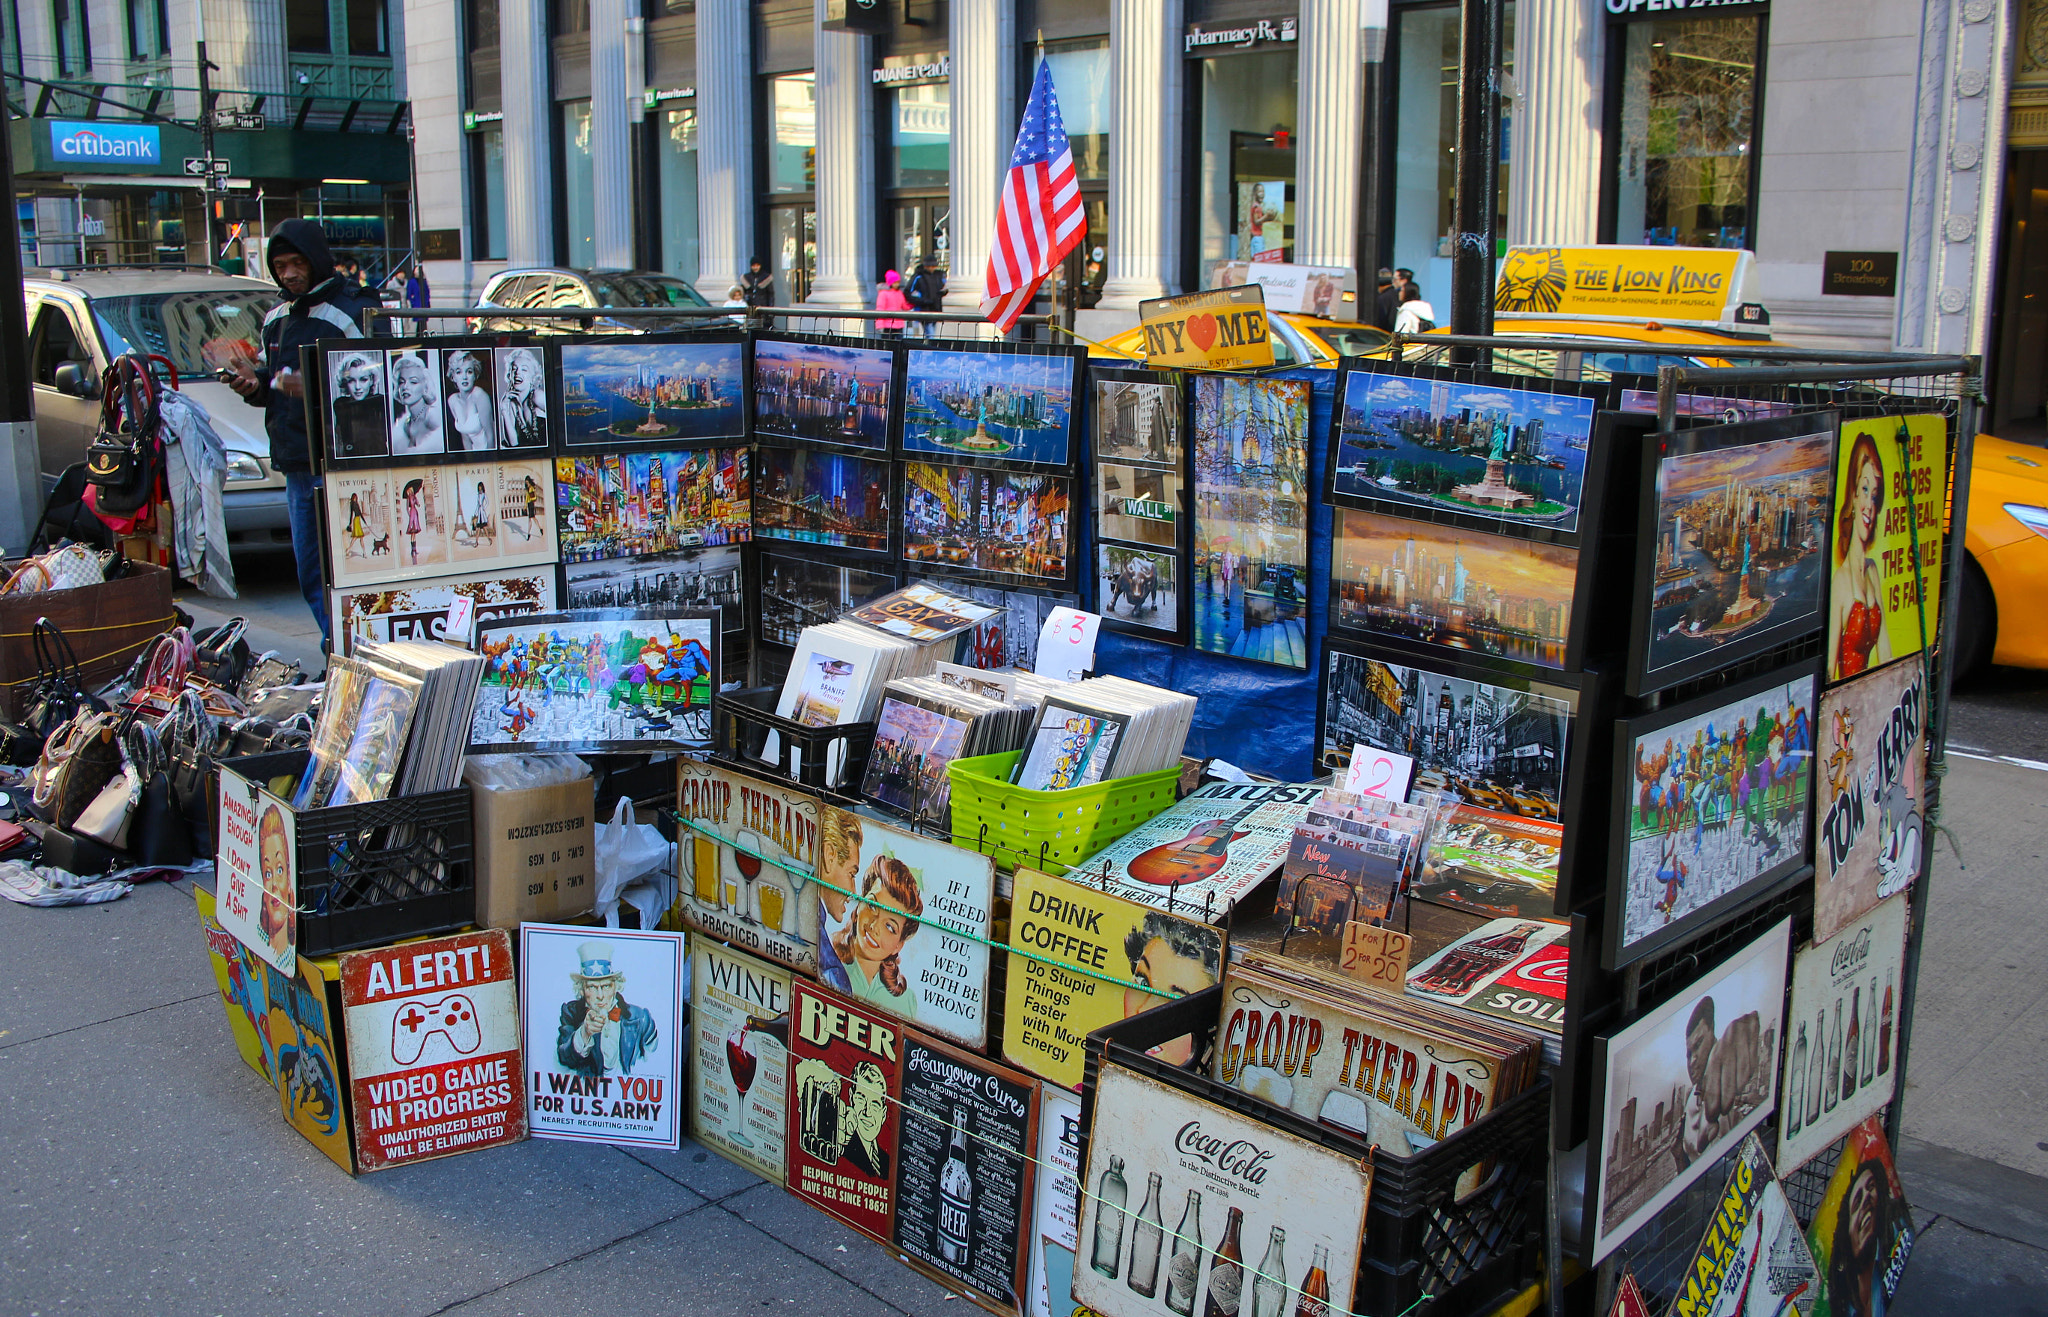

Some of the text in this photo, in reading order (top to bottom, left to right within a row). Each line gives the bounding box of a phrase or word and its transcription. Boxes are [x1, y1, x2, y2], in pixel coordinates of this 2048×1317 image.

[656, 87, 694, 100] Ameritrade
[61, 134, 152, 158] citibank
[324, 222, 375, 240] tibank
[1574, 264, 1723, 294] THE LION KING
[1832, 272, 1889, 287] Broadway
[1850, 259, 1875, 272] 100
[1170, 291, 1233, 311] NEW YORK
[1572, 295, 1586, 303] THE
[1660, 298, 1679, 306] BEST
[1681, 299, 1717, 307] MUSICAL
[1145, 310, 1266, 356] NY ME
[1215, 356, 1242, 368] STATE
[1908, 435, 1923, 462] HE
[431, 468, 440, 498] LONDON
[466, 468, 491, 476] PARIS
[1127, 500, 1173, 518] WALL ST
[1884, 506, 1907, 538] ARE
[1882, 547, 1903, 579] THE
[886, 600, 967, 626] GAY ST
[1889, 584, 1900, 613] IS
[820, 683, 846, 696] BRANIFF
[1873, 668, 1923, 807] JERRY
[1194, 784, 1323, 805] MUSI
[227, 815, 253, 848] ENOUGH
[681, 778, 817, 865] GROUP THERAPY
[1240, 823, 1285, 835] INSPIRES
[1821, 771, 1866, 882] TOM
[226, 846, 230, 861] I
[528, 853, 545, 867] KGS
[551, 851, 561, 864] 10
[1302, 844, 1331, 863] New
[230, 872, 245, 897] GIVE
[528, 882, 544, 896] KGS
[552, 880, 559, 892] 9
[947, 879, 970, 899] IF I
[1105, 886, 1120, 895] MY
[1120, 889, 1161, 904] HEART
[1224, 873, 1258, 896] WORLD
[225, 892, 231, 910] A
[232, 896, 248, 922] SHIT
[929, 894, 986, 924] AGREED
[1028, 890, 1104, 935] DRINK
[702, 911, 793, 964] PRACTICED HERE
[938, 916, 976, 936] WITH
[941, 935, 972, 961] YOU,
[1020, 921, 1108, 970] COFFEE
[1349, 923, 1406, 961] 1 FOR 12
[366, 944, 491, 999] ALERT!
[933, 954, 969, 979] WE'D
[1026, 959, 1096, 997] Do Stupid
[1342, 947, 1400, 983] 2 FOR 20
[707, 952, 782, 1014] WINE
[920, 969, 981, 1003] BOTH BE
[1025, 976, 1071, 1006] Things
[923, 988, 977, 1020] WRONG
[1024, 996, 1067, 1022] Faster
[799, 992, 896, 1062] BEER
[1022, 1014, 1087, 1050] with More
[1021, 1031, 1069, 1063] Energy
[369, 1058, 509, 1105] VIDEO GAME
[534, 1072, 663, 1103] I WANT YOU
[908, 1048, 981, 1090] Hangover
[985, 1076, 1025, 1118] Cures
[1222, 1008, 1485, 1142] GROUP THERAPY
[370, 1082, 512, 1130] IN PROGRESS
[534, 1095, 564, 1114] FOR
[610, 1103, 662, 1122] ARMY
[930, 1082, 958, 1100] AROUND
[959, 1094, 972, 1107] THE
[973, 1100, 999, 1117] WORLD
[379, 1110, 507, 1147] UNAUTHORIZED ENTRY
[541, 1116, 654, 1132] NEAREST RECRUITING STATION
[386, 1125, 504, 1160] WILL BE ELIMINATED
[802, 1164, 889, 1200] HELPING UGLY PEOPLE
[1179, 1157, 1260, 1199] In the Distinctive Bottle
[801, 1179, 888, 1215] HAVE SEX SINCE 1862!
[940, 1200, 967, 1238] BEER
[902, 1239, 1004, 1301] CHEERS TO THOSE WHO WISH US WELL!
[1724, 1247, 1746, 1295] SPIDER
[1730, 1261, 1746, 1295] MAN
